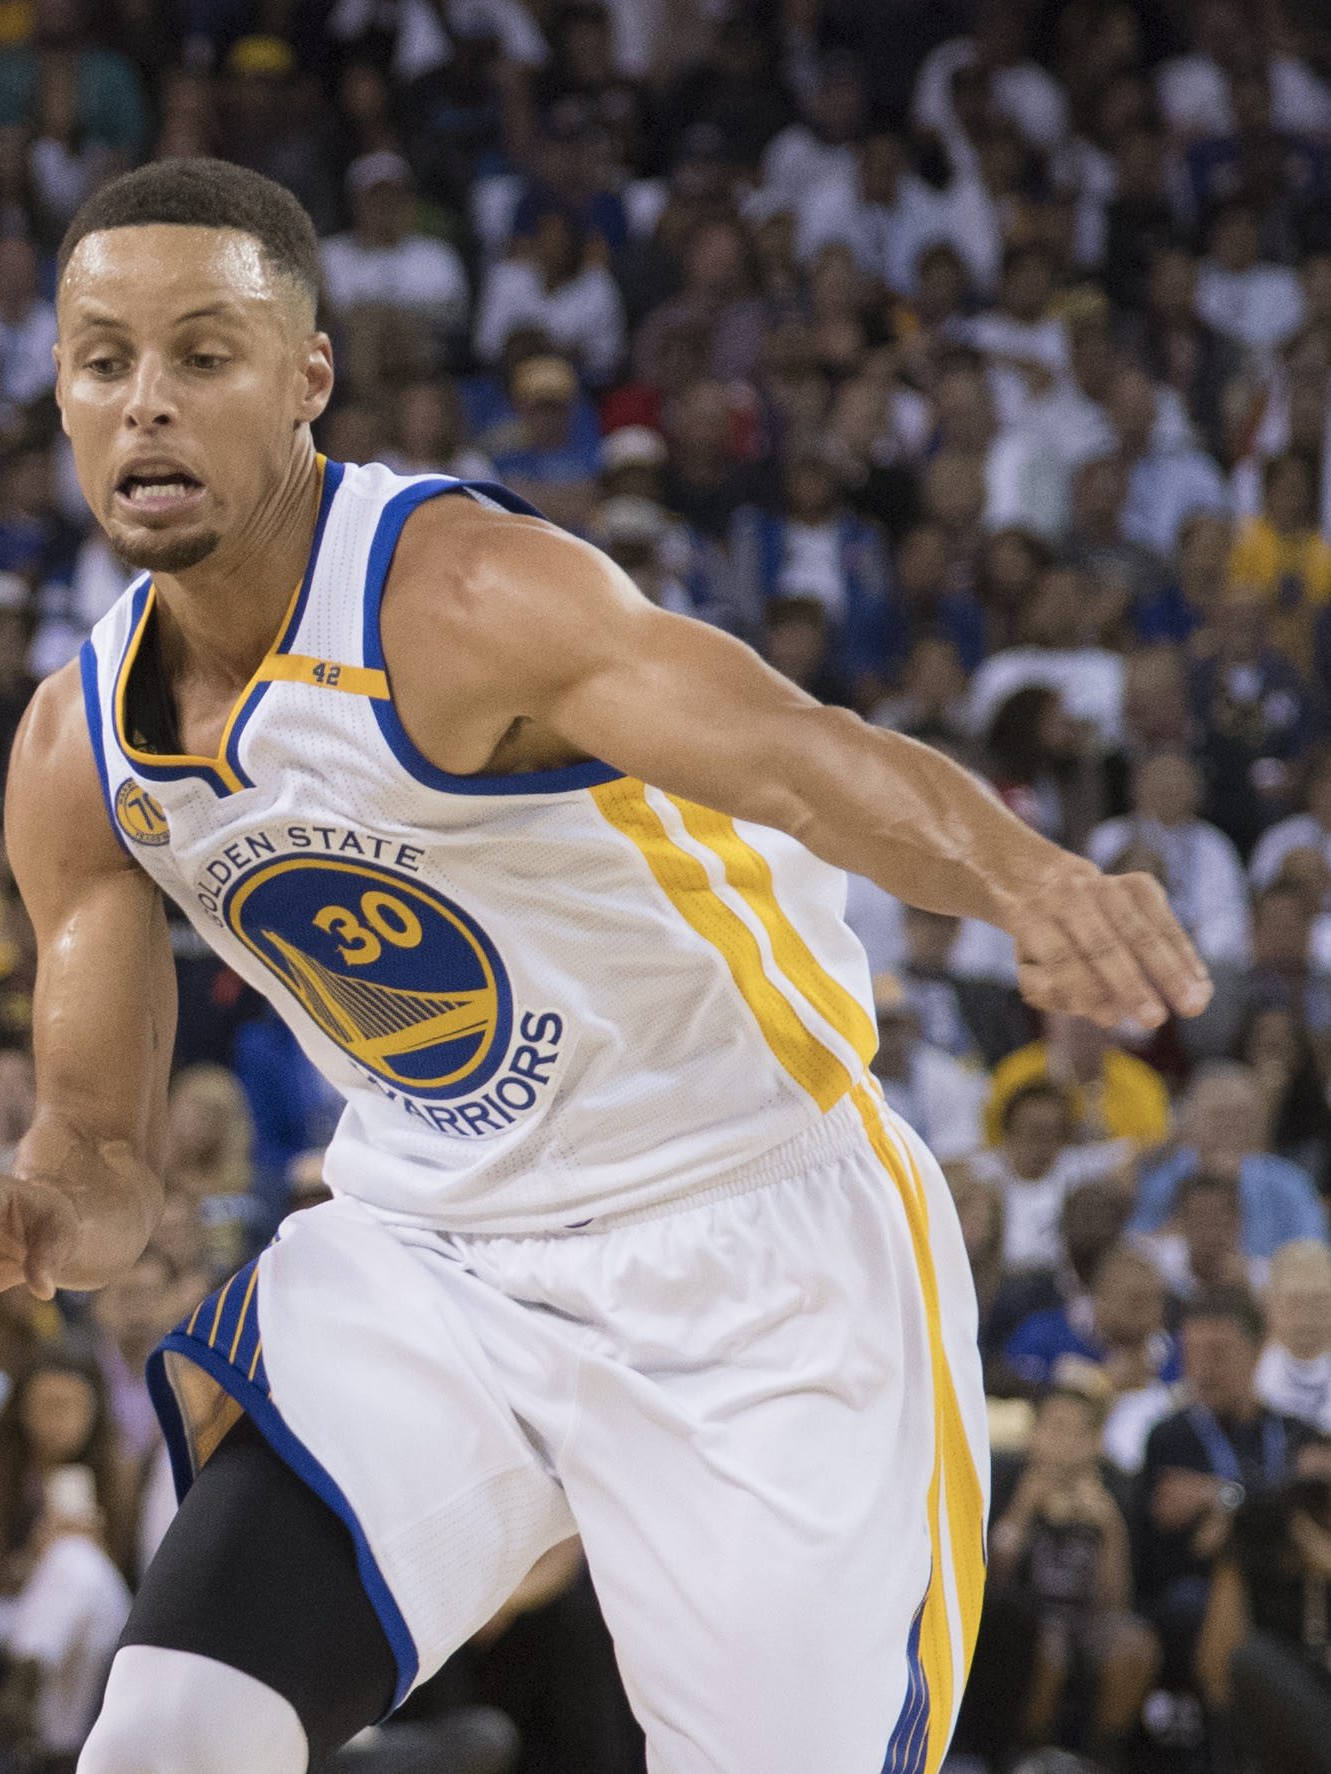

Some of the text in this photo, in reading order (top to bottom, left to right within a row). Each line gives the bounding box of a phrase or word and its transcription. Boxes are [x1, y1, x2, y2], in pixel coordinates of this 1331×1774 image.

[313, 662, 341, 686] 42
[287, 826, 425, 872] STATE
[312, 890, 423, 966] 30
[352, 1011, 563, 1136] ARRIORS
